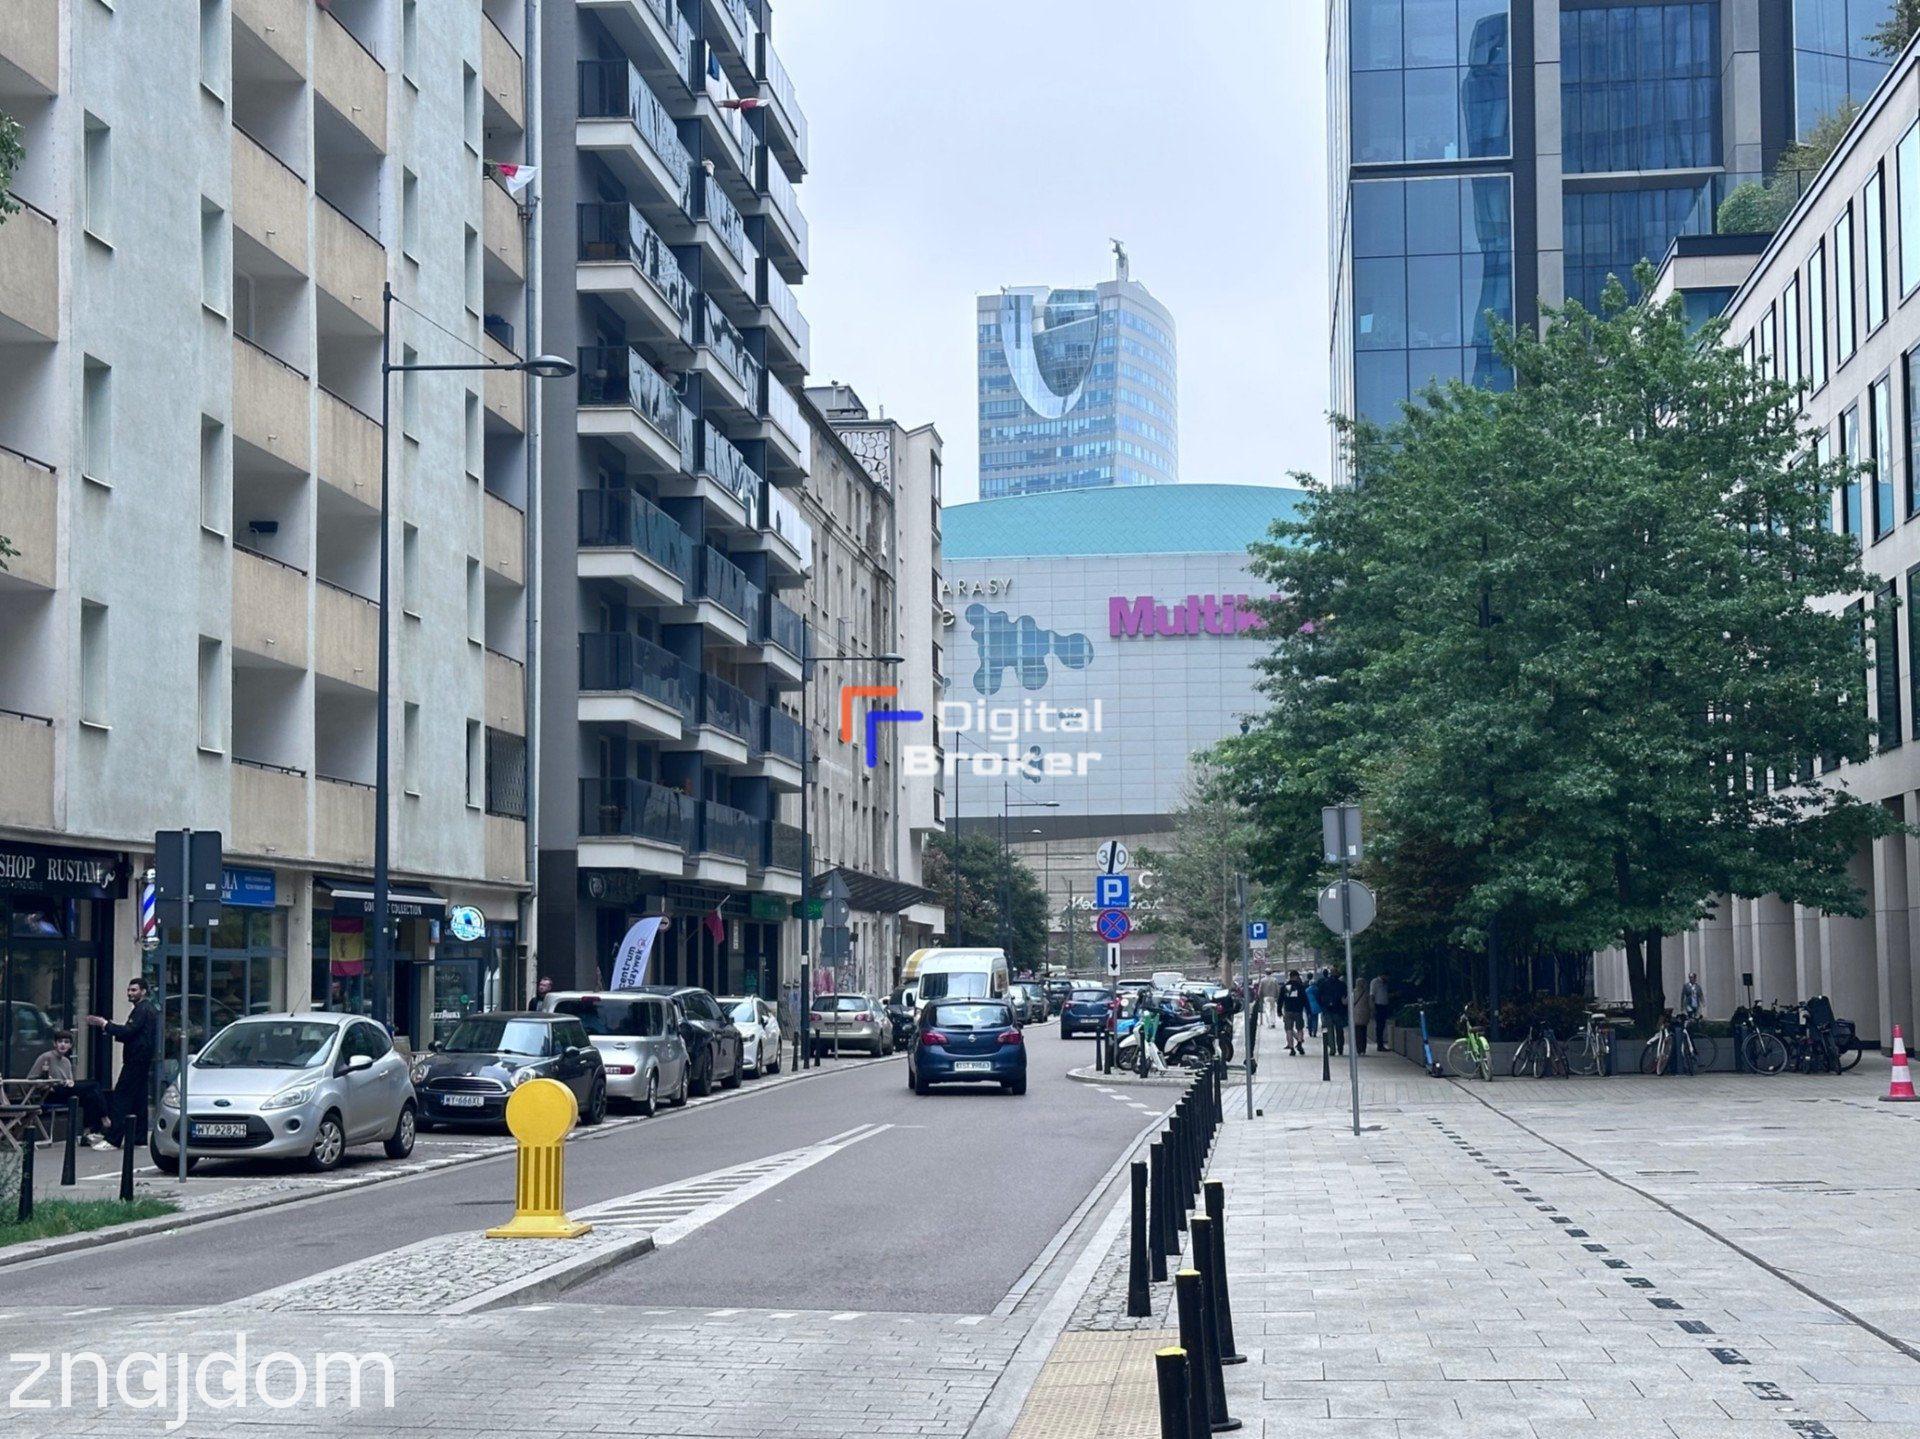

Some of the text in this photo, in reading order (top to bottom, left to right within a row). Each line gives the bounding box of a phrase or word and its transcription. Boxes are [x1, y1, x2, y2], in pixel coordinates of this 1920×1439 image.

[942, 577, 1012, 596] ARASY
[1109, 594, 1318, 637] Multik
[1099, 850, 1127, 865] 30
[1103, 879, 1123, 905] P
[1253, 923, 1264, 938] P
